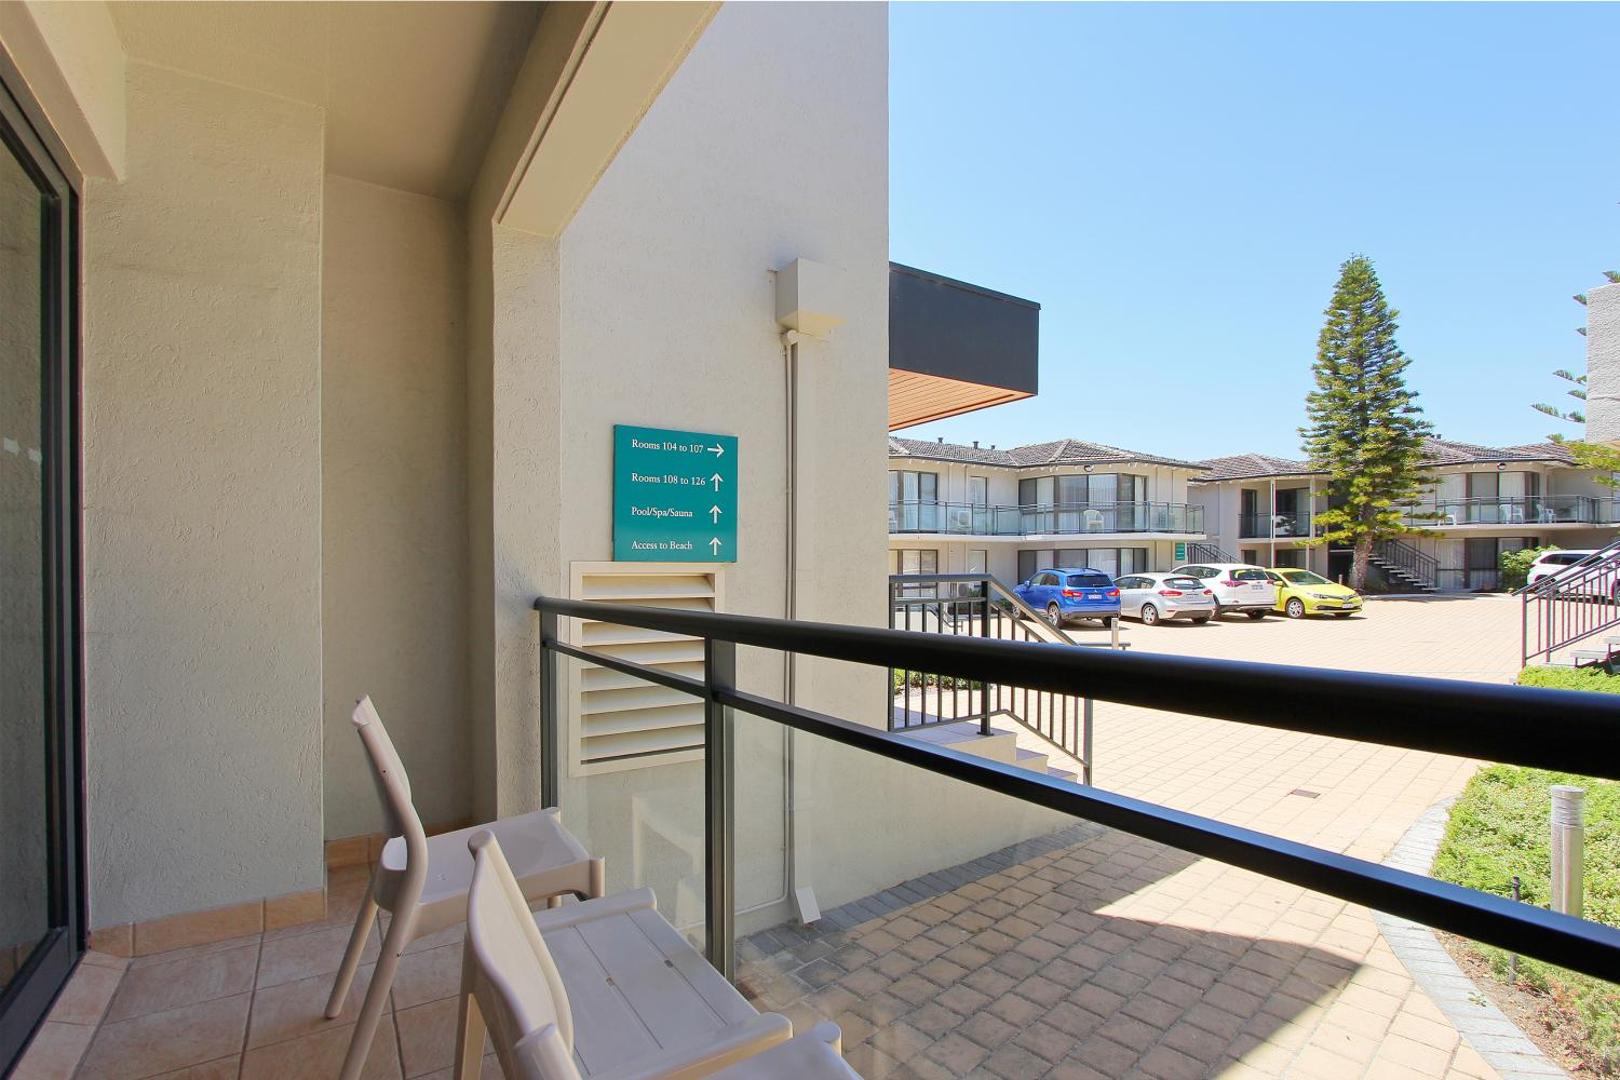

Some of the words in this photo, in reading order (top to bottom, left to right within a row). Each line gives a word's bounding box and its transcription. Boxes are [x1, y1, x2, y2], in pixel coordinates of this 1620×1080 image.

[632, 439, 660, 450] Rooms
[663, 442, 677, 450] 104
[690, 444, 703, 453] 107
[632, 473, 660, 482] Rooms
[664, 475, 677, 484] 108
[692, 477, 706, 485] 126
[632, 506, 693, 518] Pool/Spa/Sauna
[632, 541, 657, 550] Access
[670, 541, 692, 550] Beach
